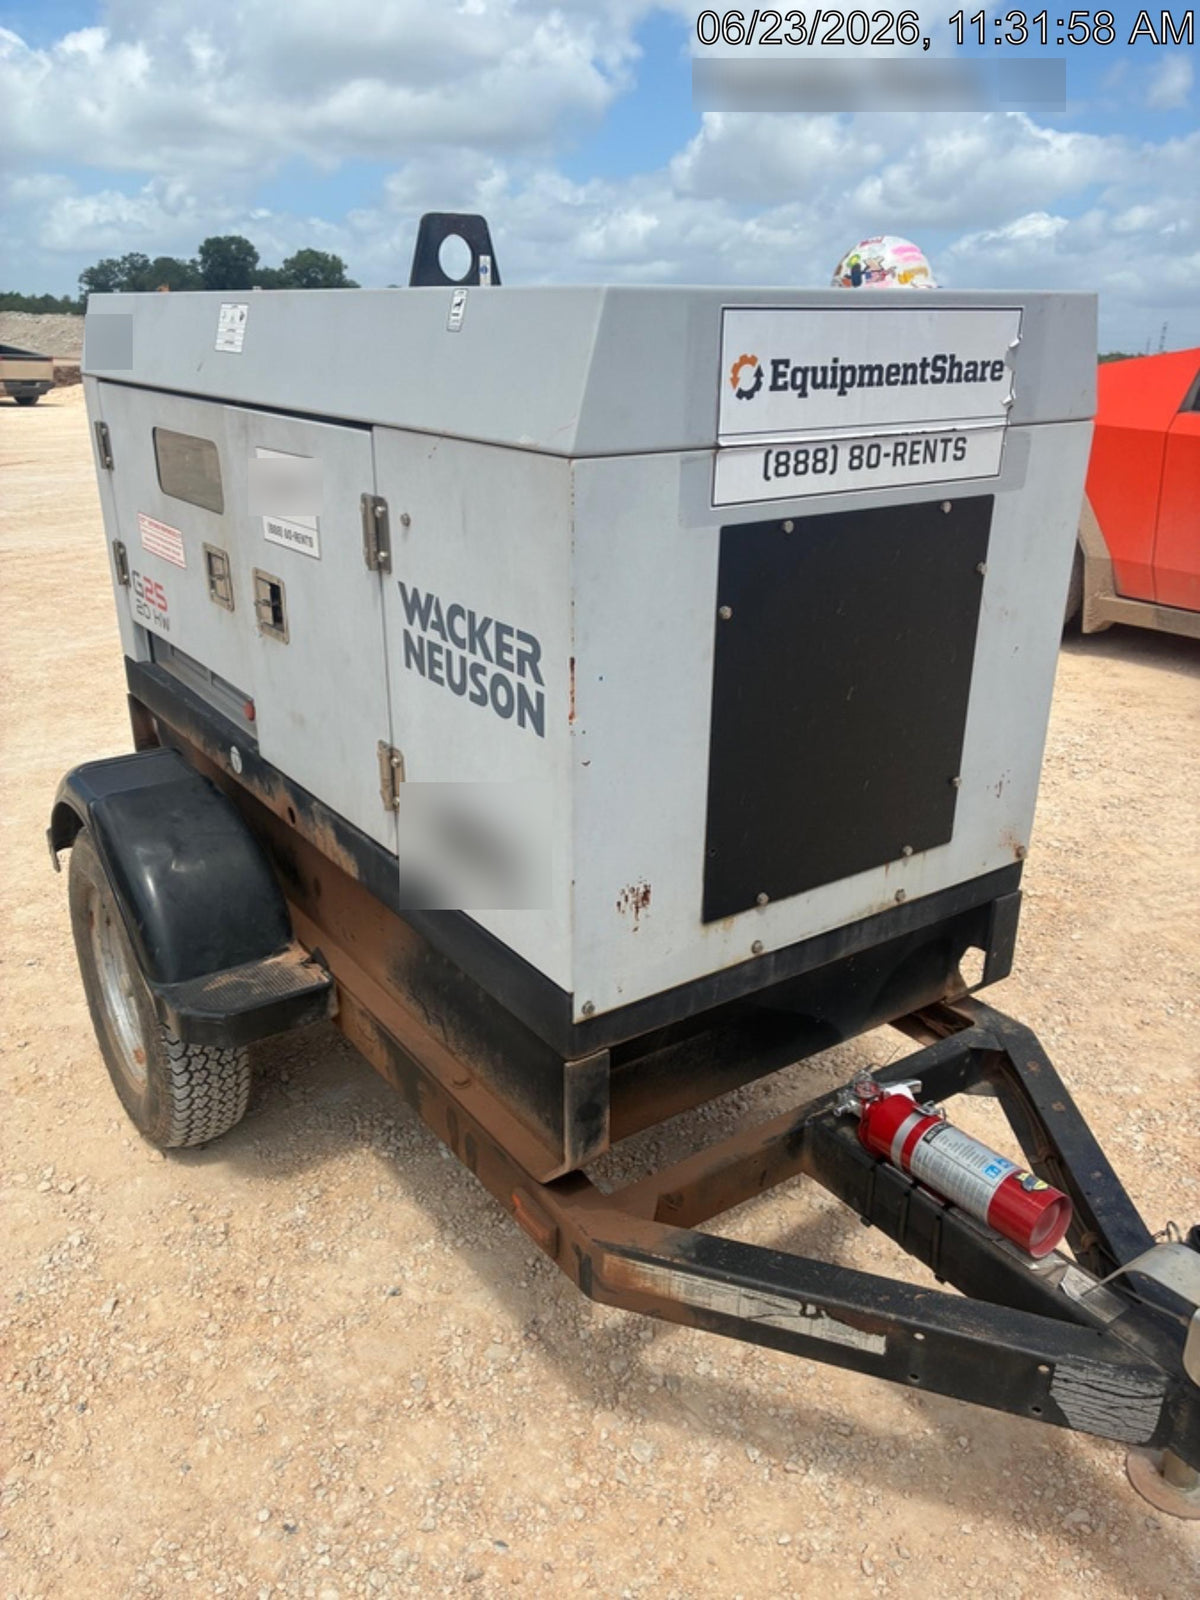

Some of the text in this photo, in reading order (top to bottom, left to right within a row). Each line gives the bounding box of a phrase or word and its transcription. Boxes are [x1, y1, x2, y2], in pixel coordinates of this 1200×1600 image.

[768, 354, 1004, 399] EquipmentShare
[763, 436, 967, 481] (888) 80-RENTS
[132, 569, 168, 613] G25
[398, 580, 545, 687] WACKER
[403, 628, 545, 738] NEUSON
